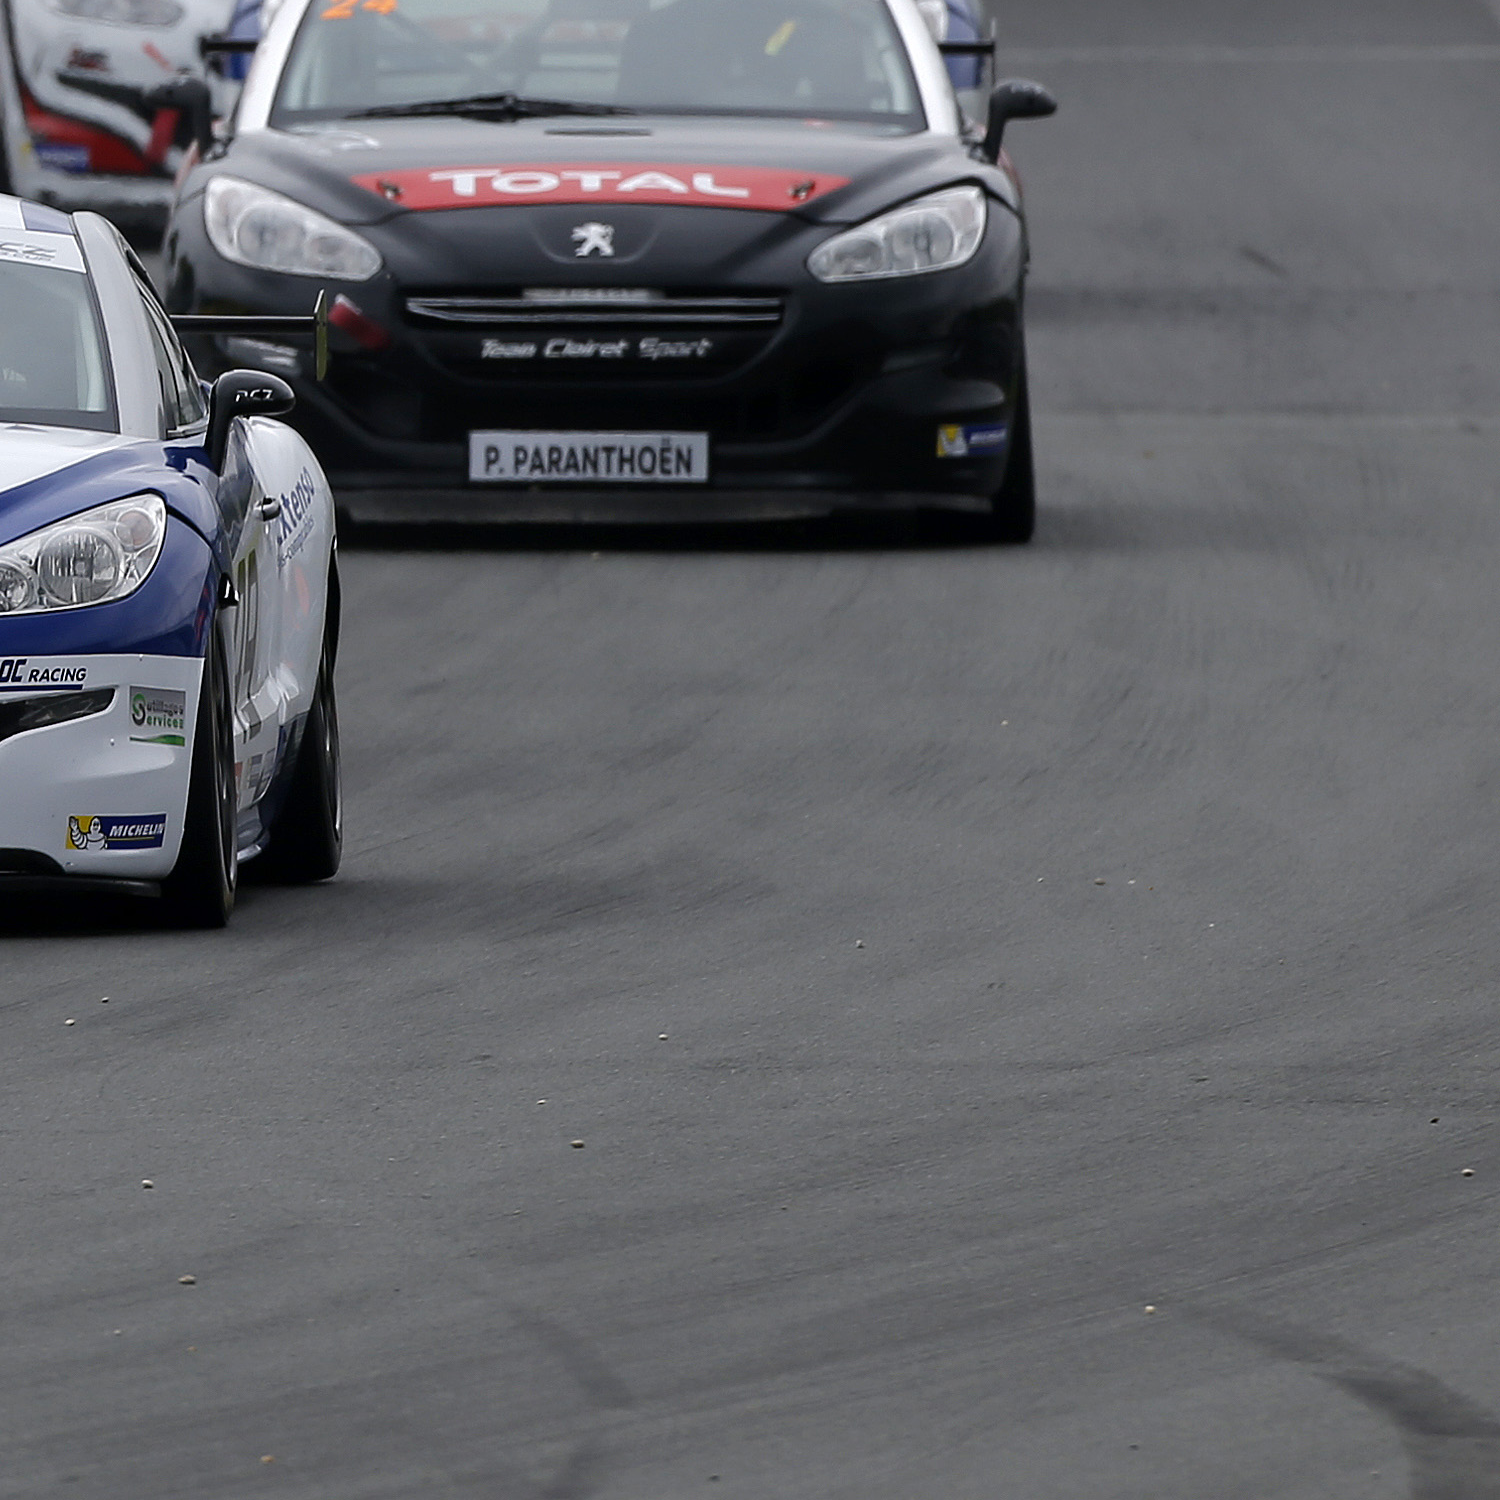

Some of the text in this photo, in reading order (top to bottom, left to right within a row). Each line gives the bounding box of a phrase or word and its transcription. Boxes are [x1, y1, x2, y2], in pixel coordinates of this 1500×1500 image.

[429, 169, 749, 197] TOTAL
[485, 438, 693, 475] P. PARANTHOËN
[28, 667, 87, 682] RACING
[108, 822, 165, 838] MICHELIN
